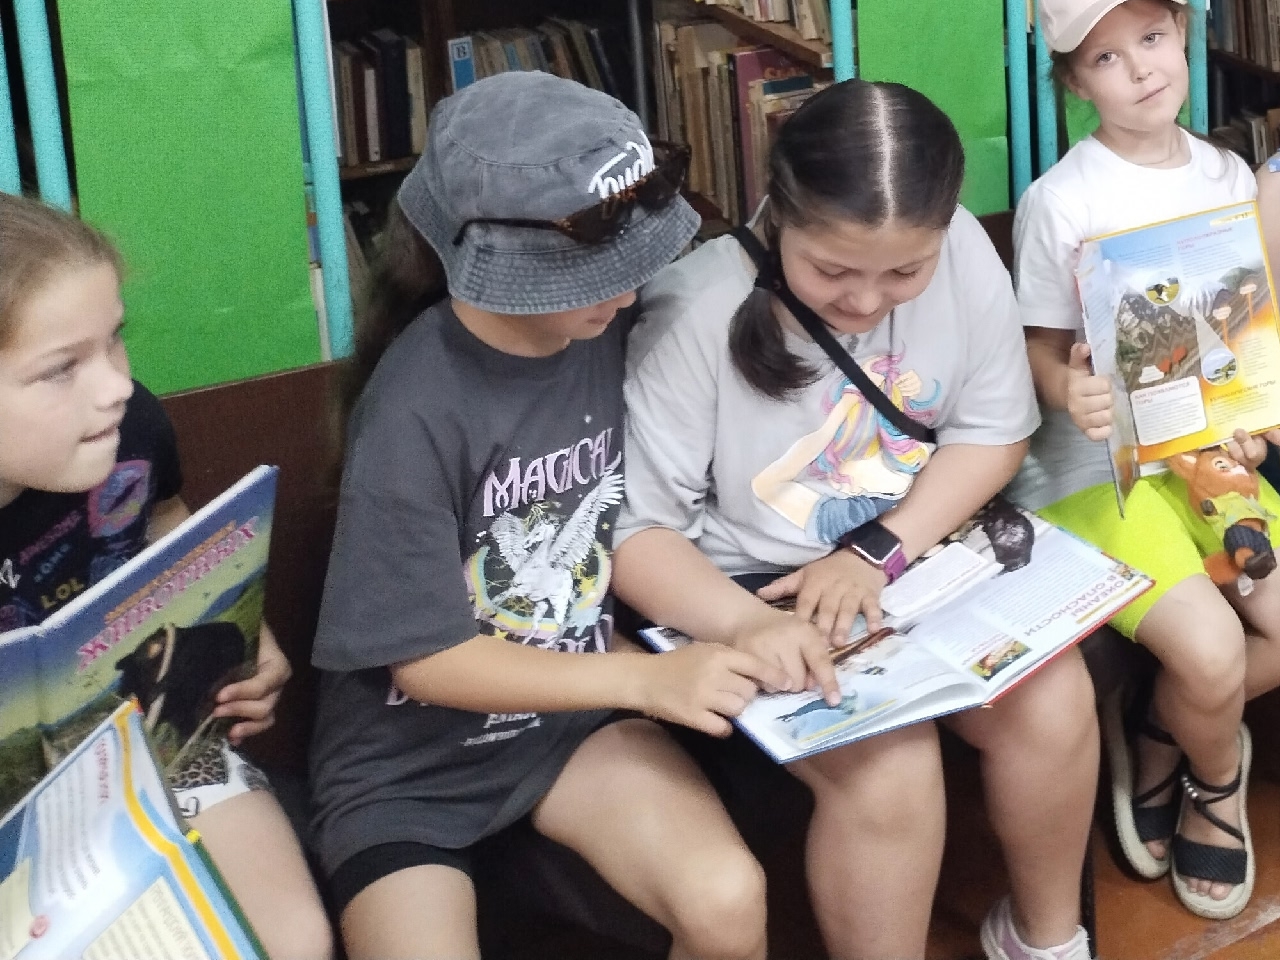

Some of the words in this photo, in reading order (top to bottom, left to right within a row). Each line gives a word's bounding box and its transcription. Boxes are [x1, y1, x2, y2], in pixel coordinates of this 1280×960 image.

[483, 427, 622, 517] MAGICAL
[41, 577, 85, 609] LOL
[1023, 581, 1107, 637] ОПАСНОСТИ
[1071, 580, 1125, 618] ОКЕАНЫ
